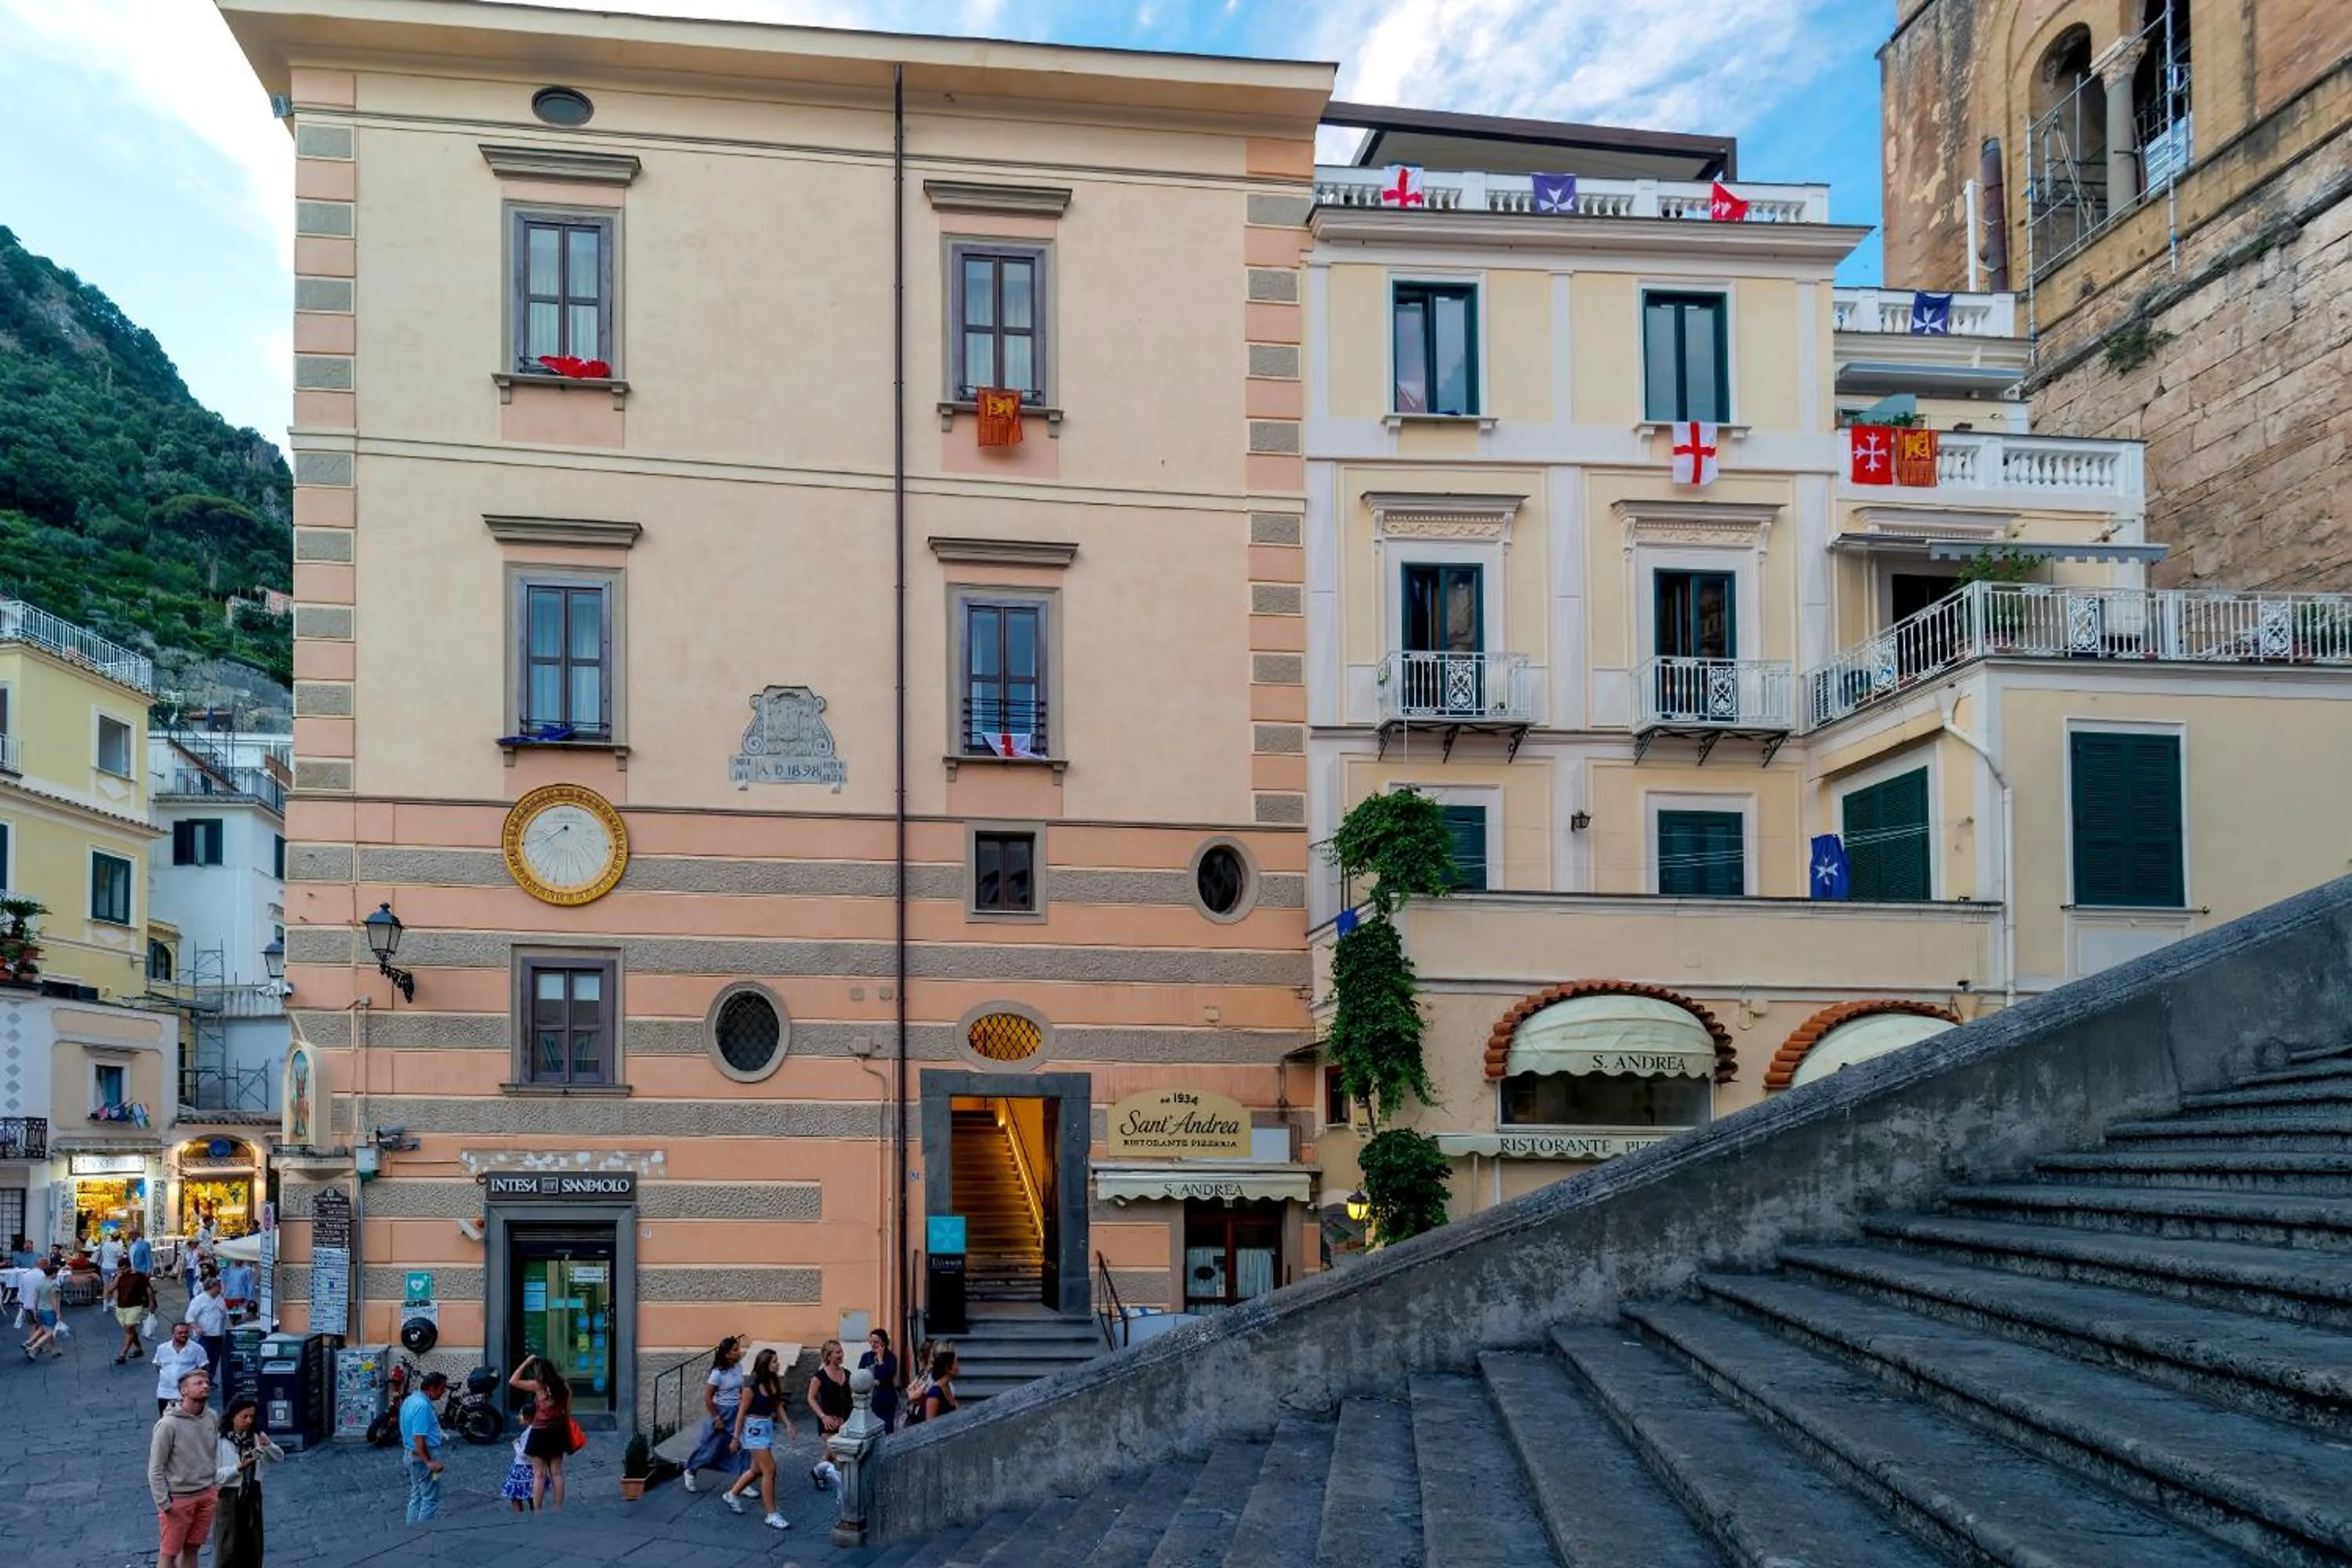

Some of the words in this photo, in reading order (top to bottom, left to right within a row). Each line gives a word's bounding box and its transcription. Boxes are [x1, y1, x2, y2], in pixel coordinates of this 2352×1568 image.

[1592, 1054, 1608, 1069] S.
[1614, 1055, 1686, 1070] ANDREA
[1174, 1092, 1198, 1106] 1934
[1191, 1139, 1237, 1148] PIZZERIA
[1500, 1138, 1611, 1152] RISTORANTE
[491, 1178, 538, 1192] INTESA
[561, 1178, 630, 1192] SANPAOLO
[1180, 1183, 1243, 1196] ANDREA
